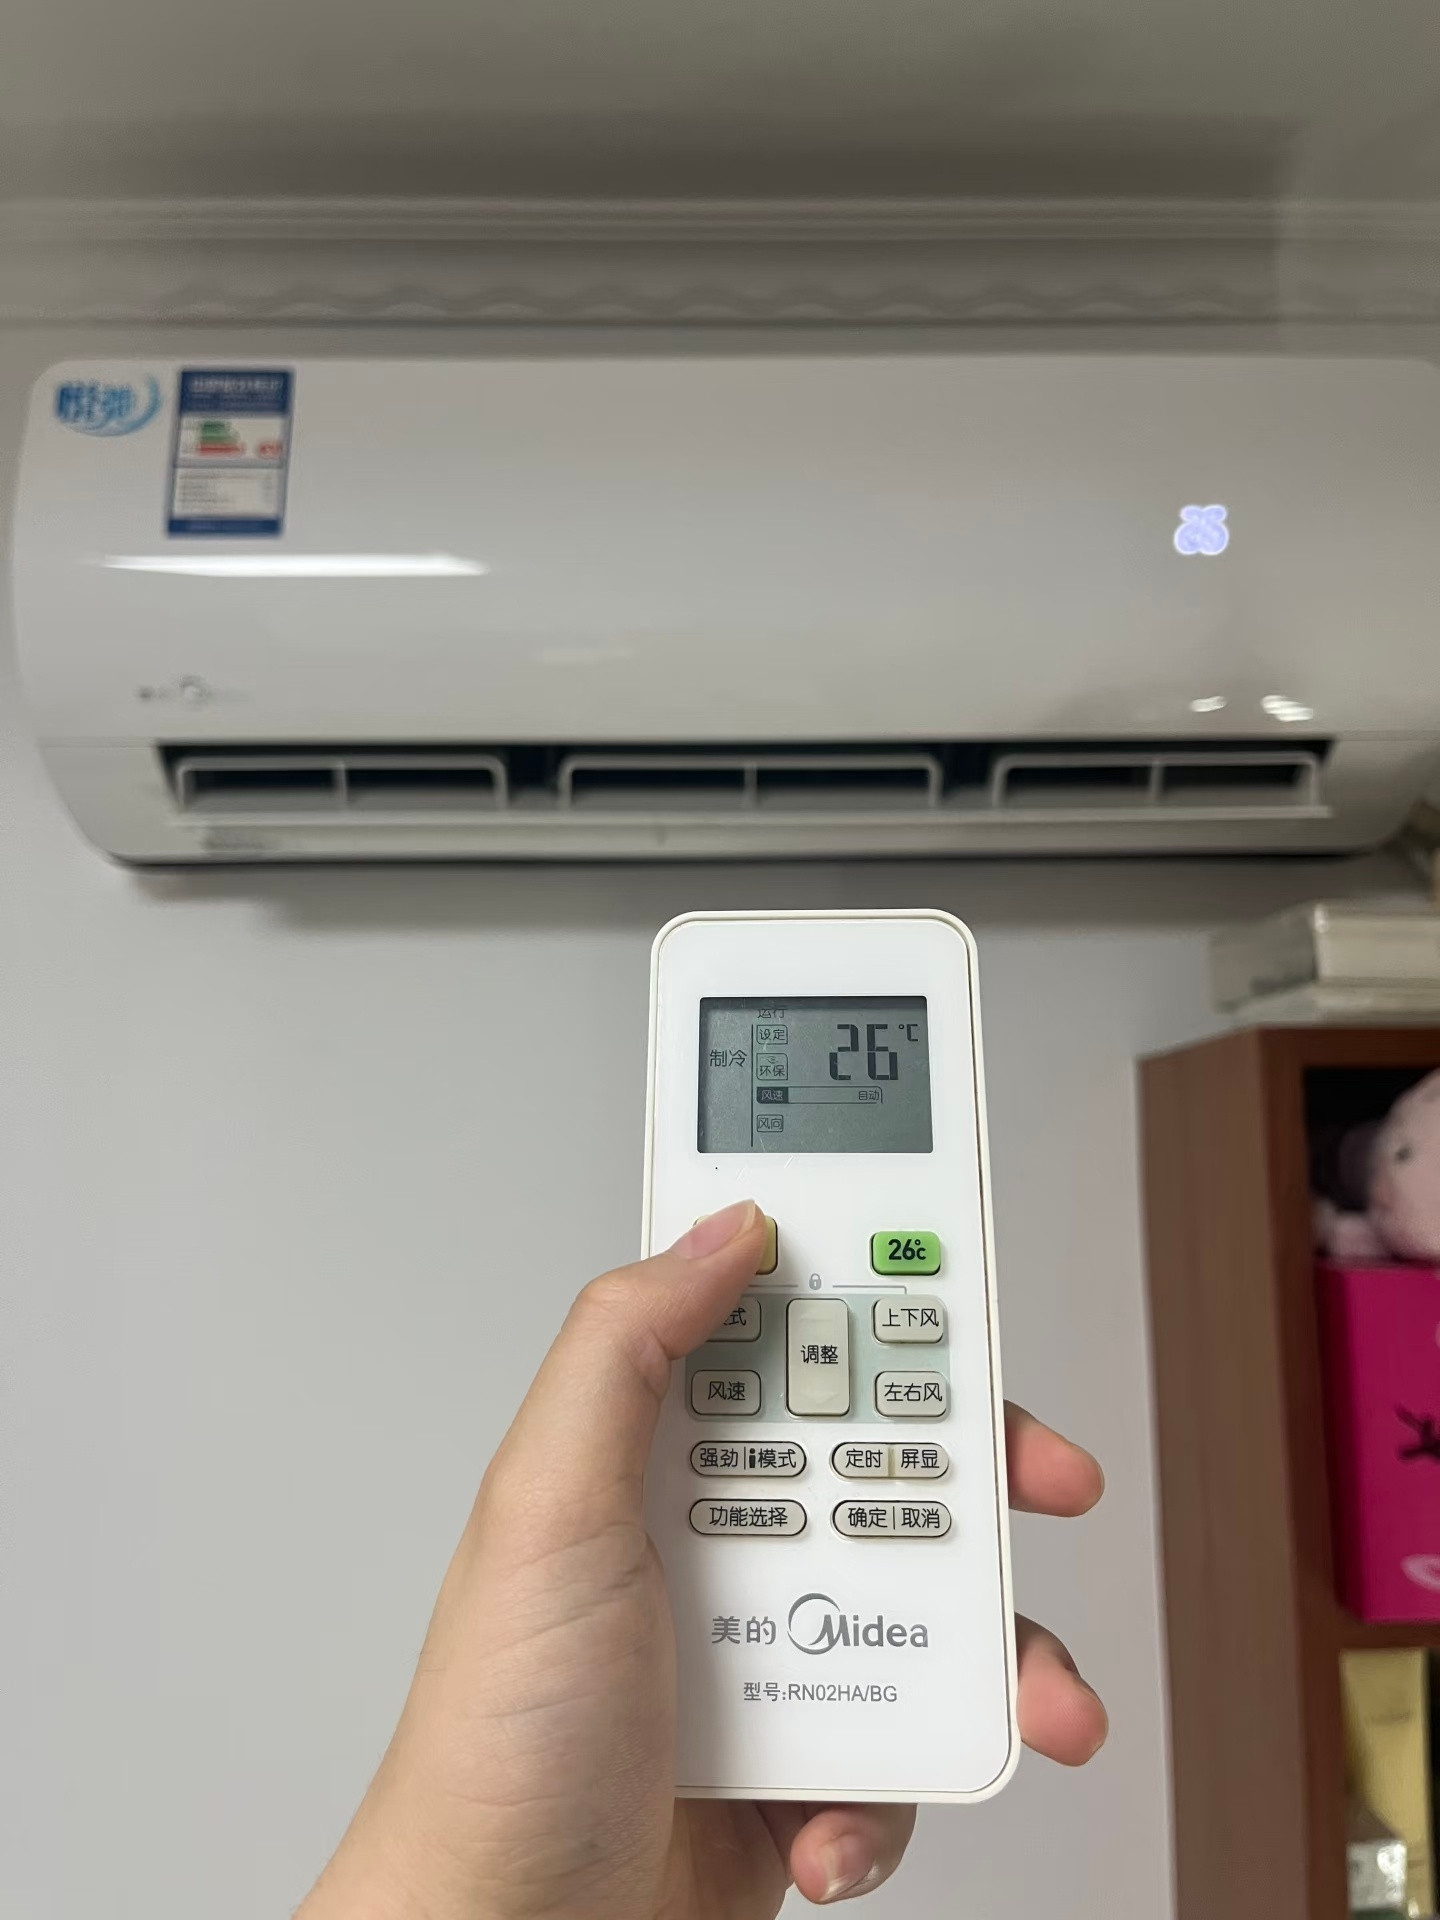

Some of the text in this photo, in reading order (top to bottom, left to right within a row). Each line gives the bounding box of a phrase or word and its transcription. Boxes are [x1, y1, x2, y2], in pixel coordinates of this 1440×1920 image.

[759, 1026, 786, 1041] 设定
[709, 1049, 748, 1068] 制冷
[759, 1065, 786, 1077] 环保
[858, 1090, 880, 1102] 自动
[758, 1117, 783, 1130] 风向
[723, 1307, 747, 1326] 式
[881, 1308, 940, 1328] 上下风
[800, 1345, 839, 1365] 调整
[707, 1381, 746, 1401] 风速
[884, 1383, 943, 1403] 左右风
[699, 1448, 738, 1468] 强劲
[845, 1448, 940, 1469] 定时 屏显
[709, 1506, 789, 1527] 功能选择
[847, 1507, 941, 1529] 确定 取消
[711, 1612, 929, 1649] 美的 Midea
